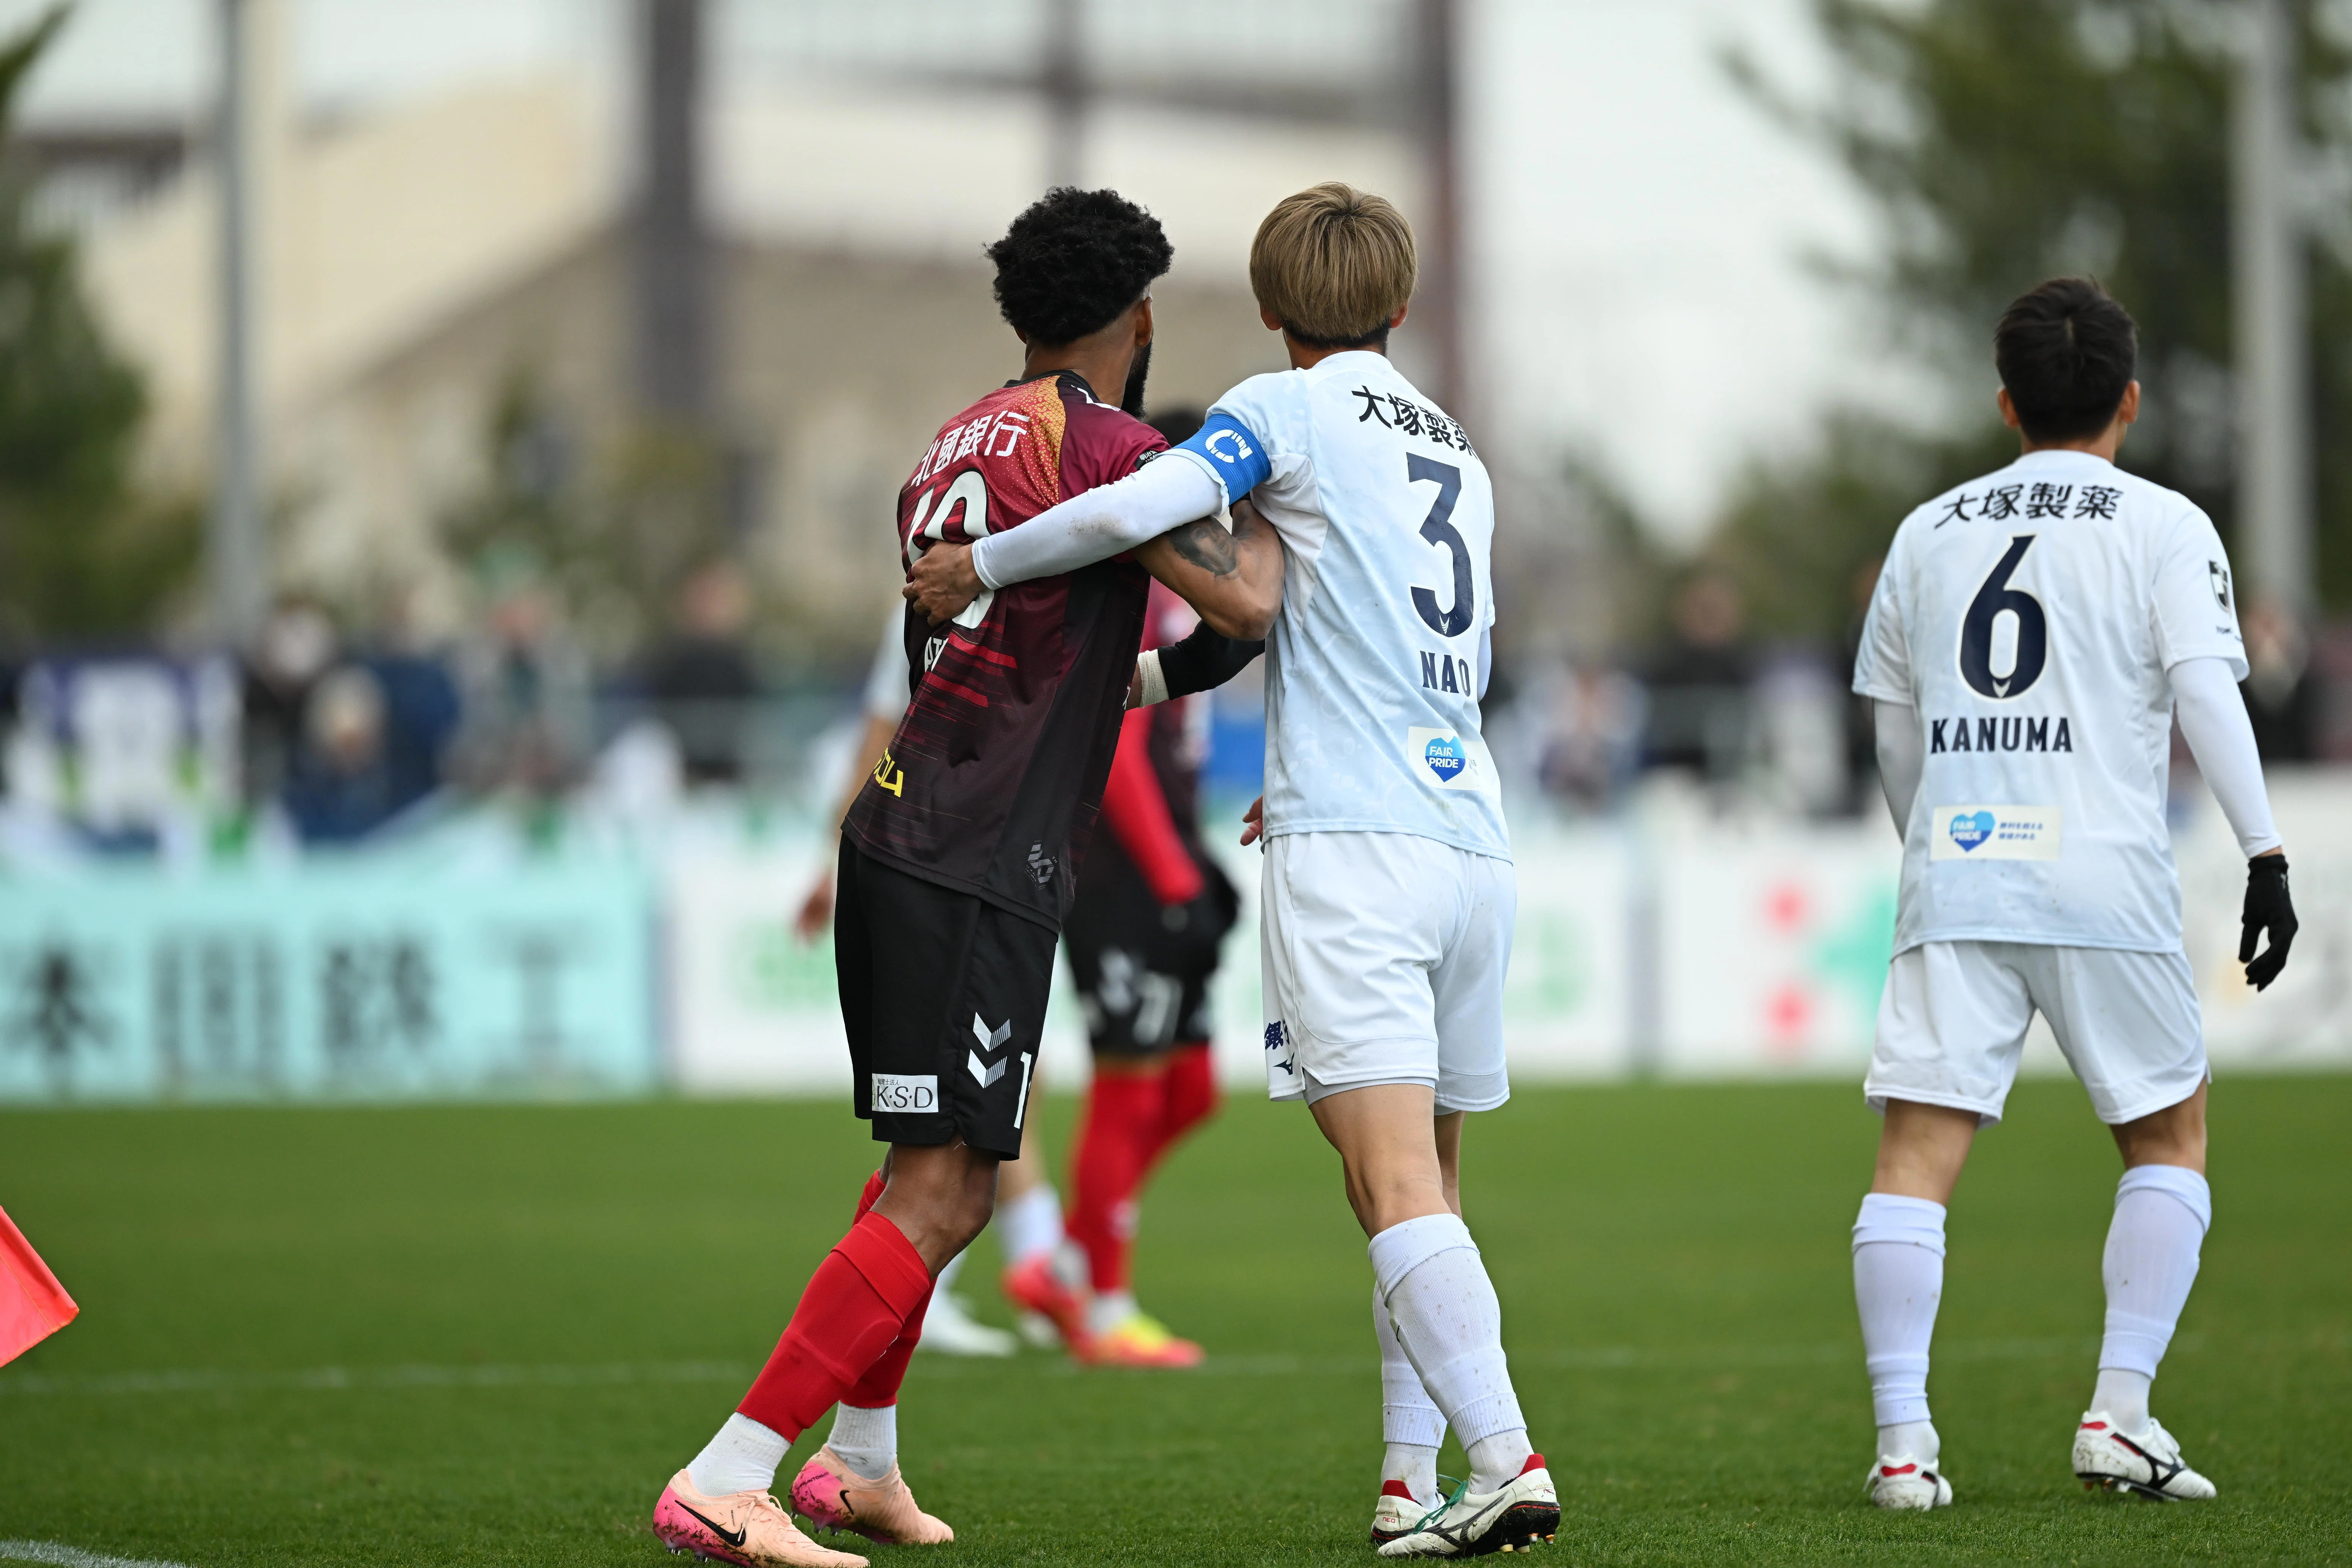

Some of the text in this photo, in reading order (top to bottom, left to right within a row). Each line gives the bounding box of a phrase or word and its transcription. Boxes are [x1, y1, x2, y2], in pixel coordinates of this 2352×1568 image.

[1351, 385, 1478, 461] 大塚製薬
[911, 410, 1030, 487] 北國銀行
[1935, 482, 2124, 528] 大塚製薬
[1406, 452, 1473, 637] 3
[1960, 534, 2046, 698] 6
[1420, 650, 1470, 697] NAO
[1429, 746, 1453, 757] FAIR
[1931, 717, 2072, 754] KANUMA
[1429, 757, 1459, 768] PRIDE
[1952, 820, 1976, 830] FAIR
[1952, 830, 1981, 841] PRIDE
[1014, 1051, 1032, 1129] 1
